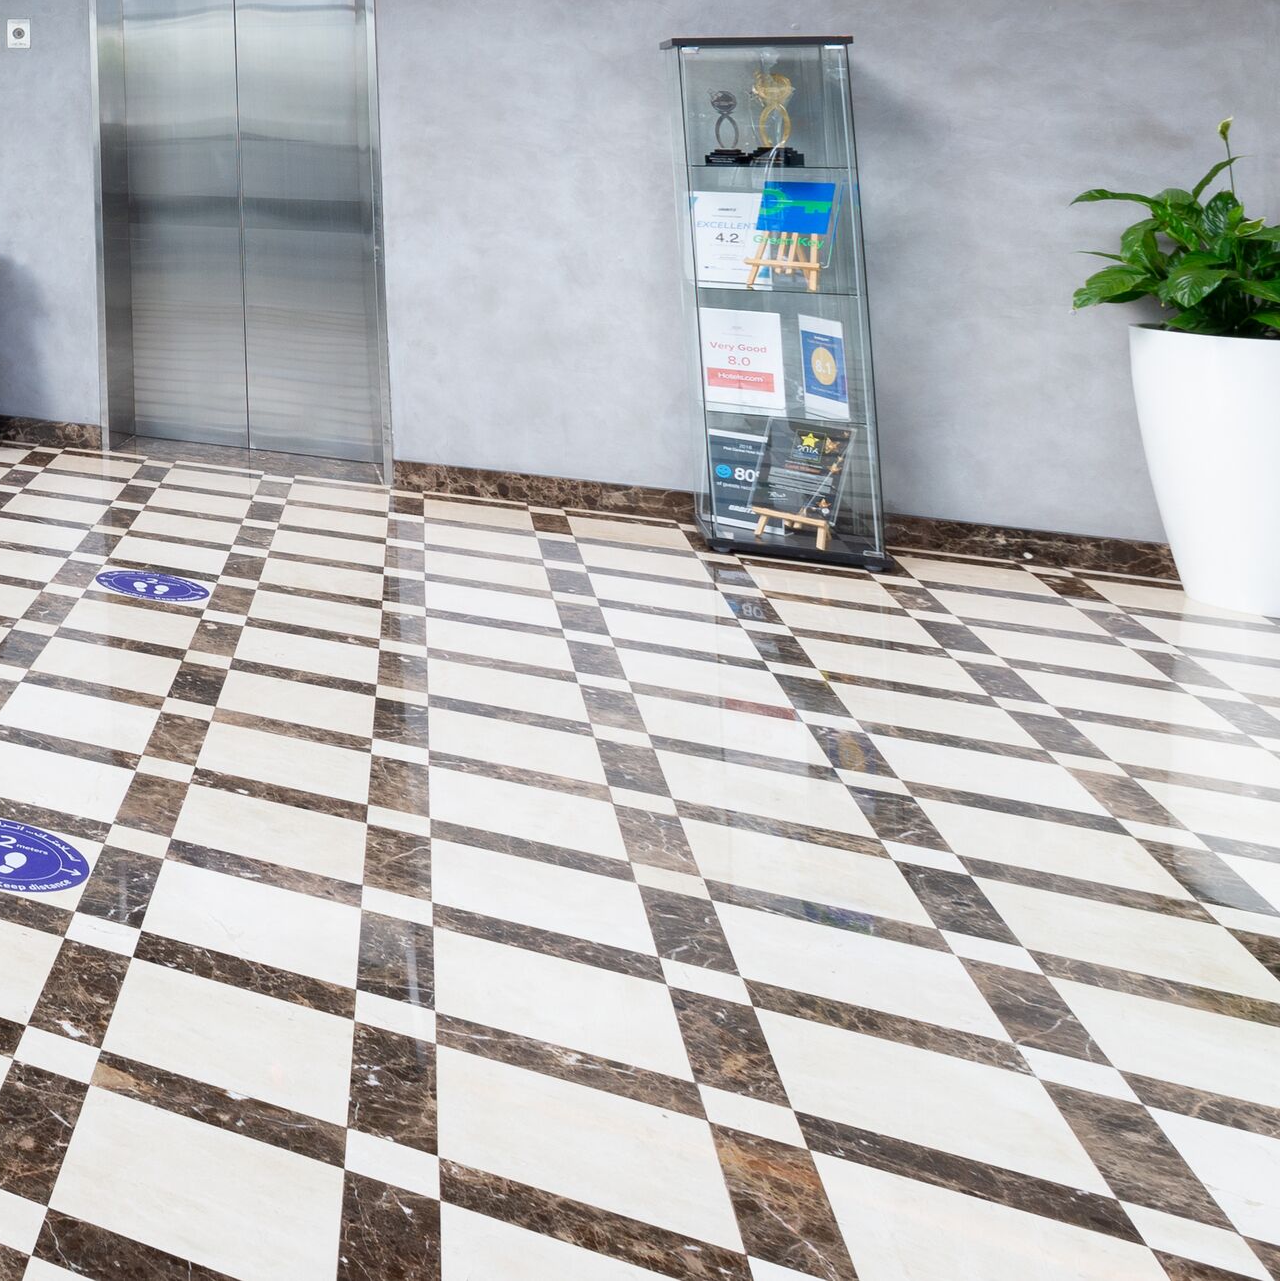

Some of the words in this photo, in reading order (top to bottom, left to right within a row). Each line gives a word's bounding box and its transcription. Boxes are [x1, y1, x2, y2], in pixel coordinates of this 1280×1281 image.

[715, 232, 740, 244] 4.2
[752, 234, 795, 246] Green
[797, 237, 825, 250] Key
[709, 341, 736, 352] Very
[737, 343, 768, 354] Good
[727, 355, 751, 367] 8.0
[815, 359, 832, 375] 8.1
[717, 372, 765, 383] Hotels.com
[16, 843, 49, 856] meters
[28, 878, 72, 891] distance
